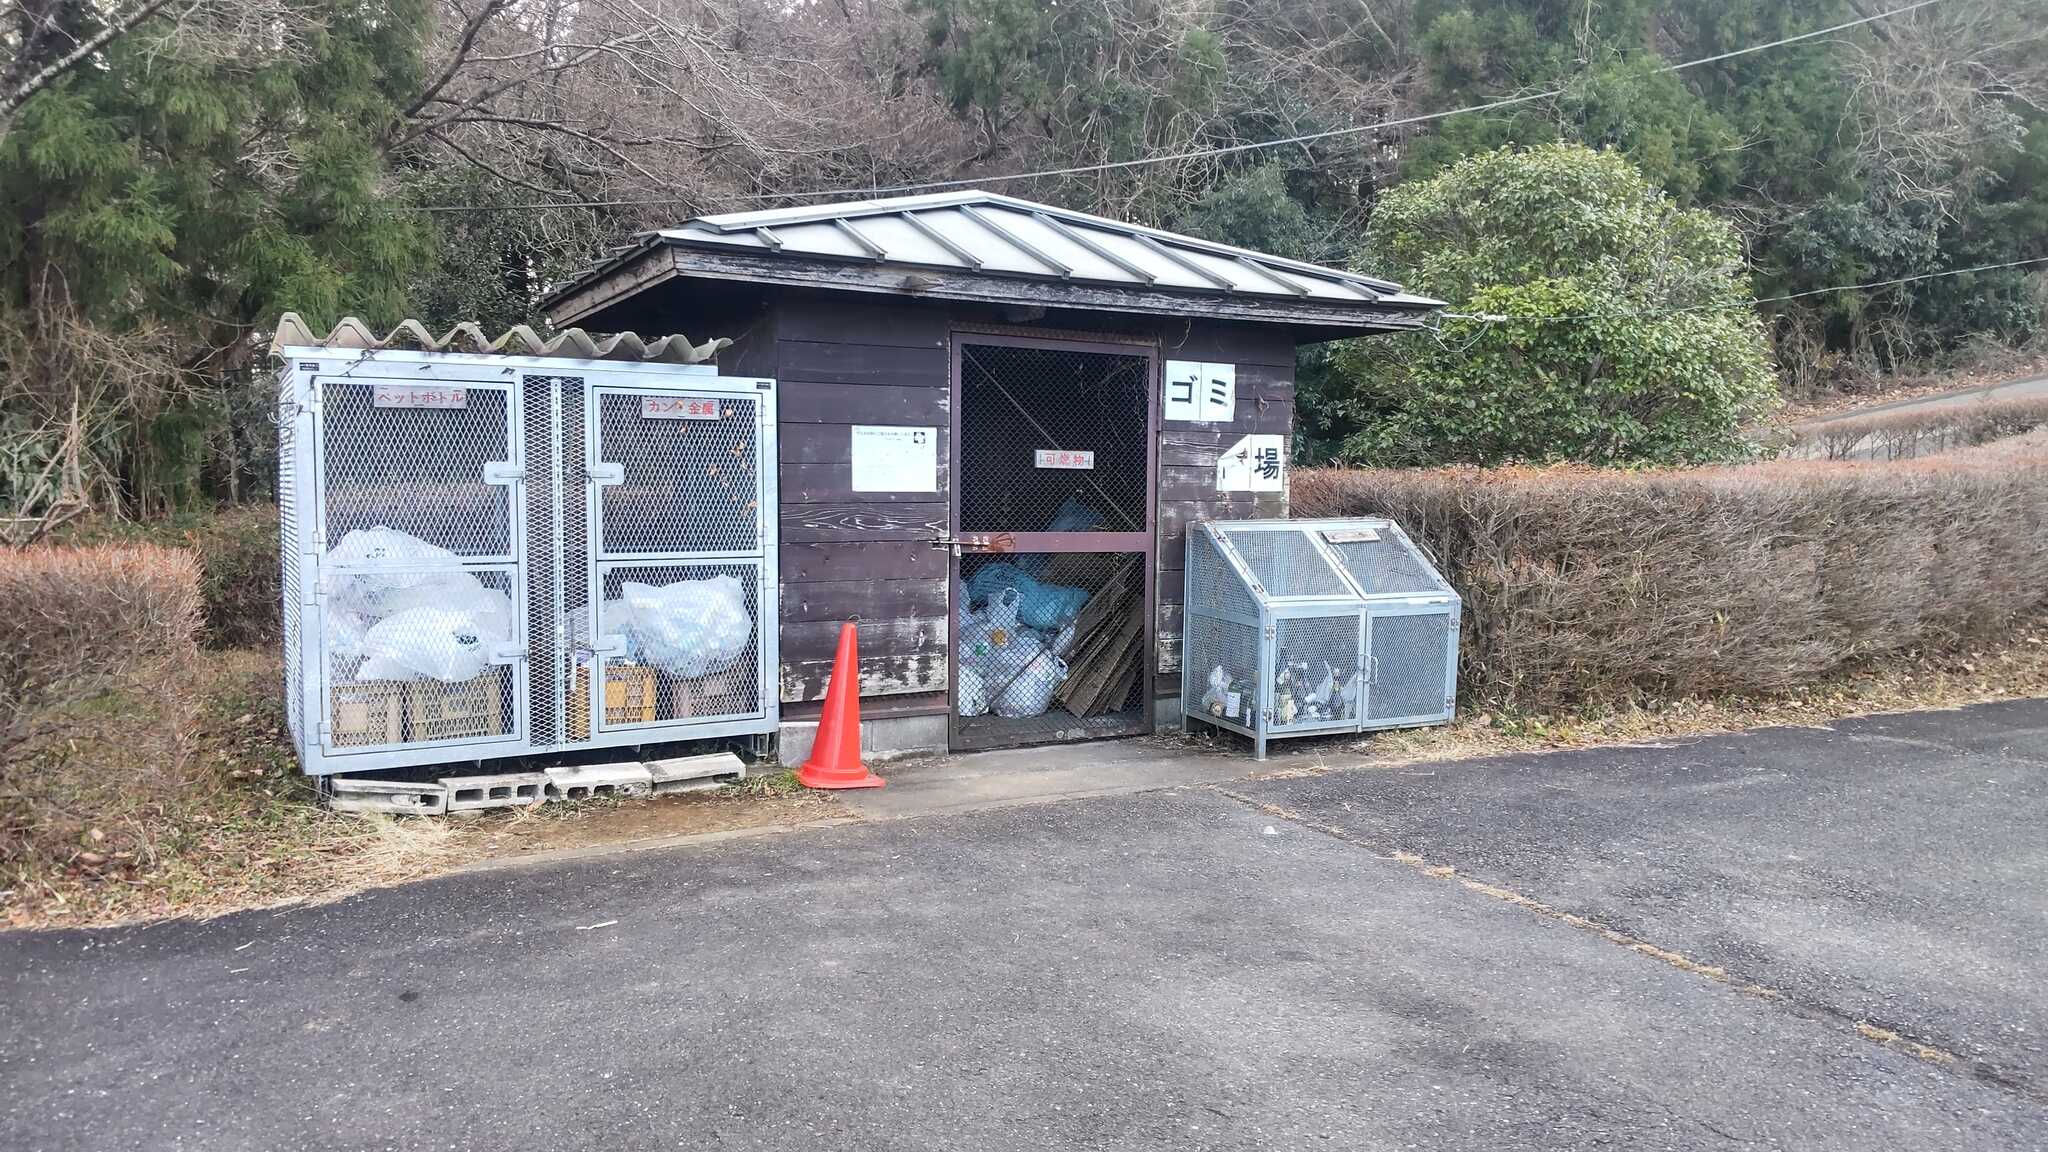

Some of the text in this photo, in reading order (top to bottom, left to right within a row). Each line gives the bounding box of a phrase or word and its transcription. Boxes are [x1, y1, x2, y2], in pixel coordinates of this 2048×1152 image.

[378, 391, 463, 404] ペットボトル
[1171, 375, 1228, 407] ゴミ
[648, 400, 715, 416] カン金属
